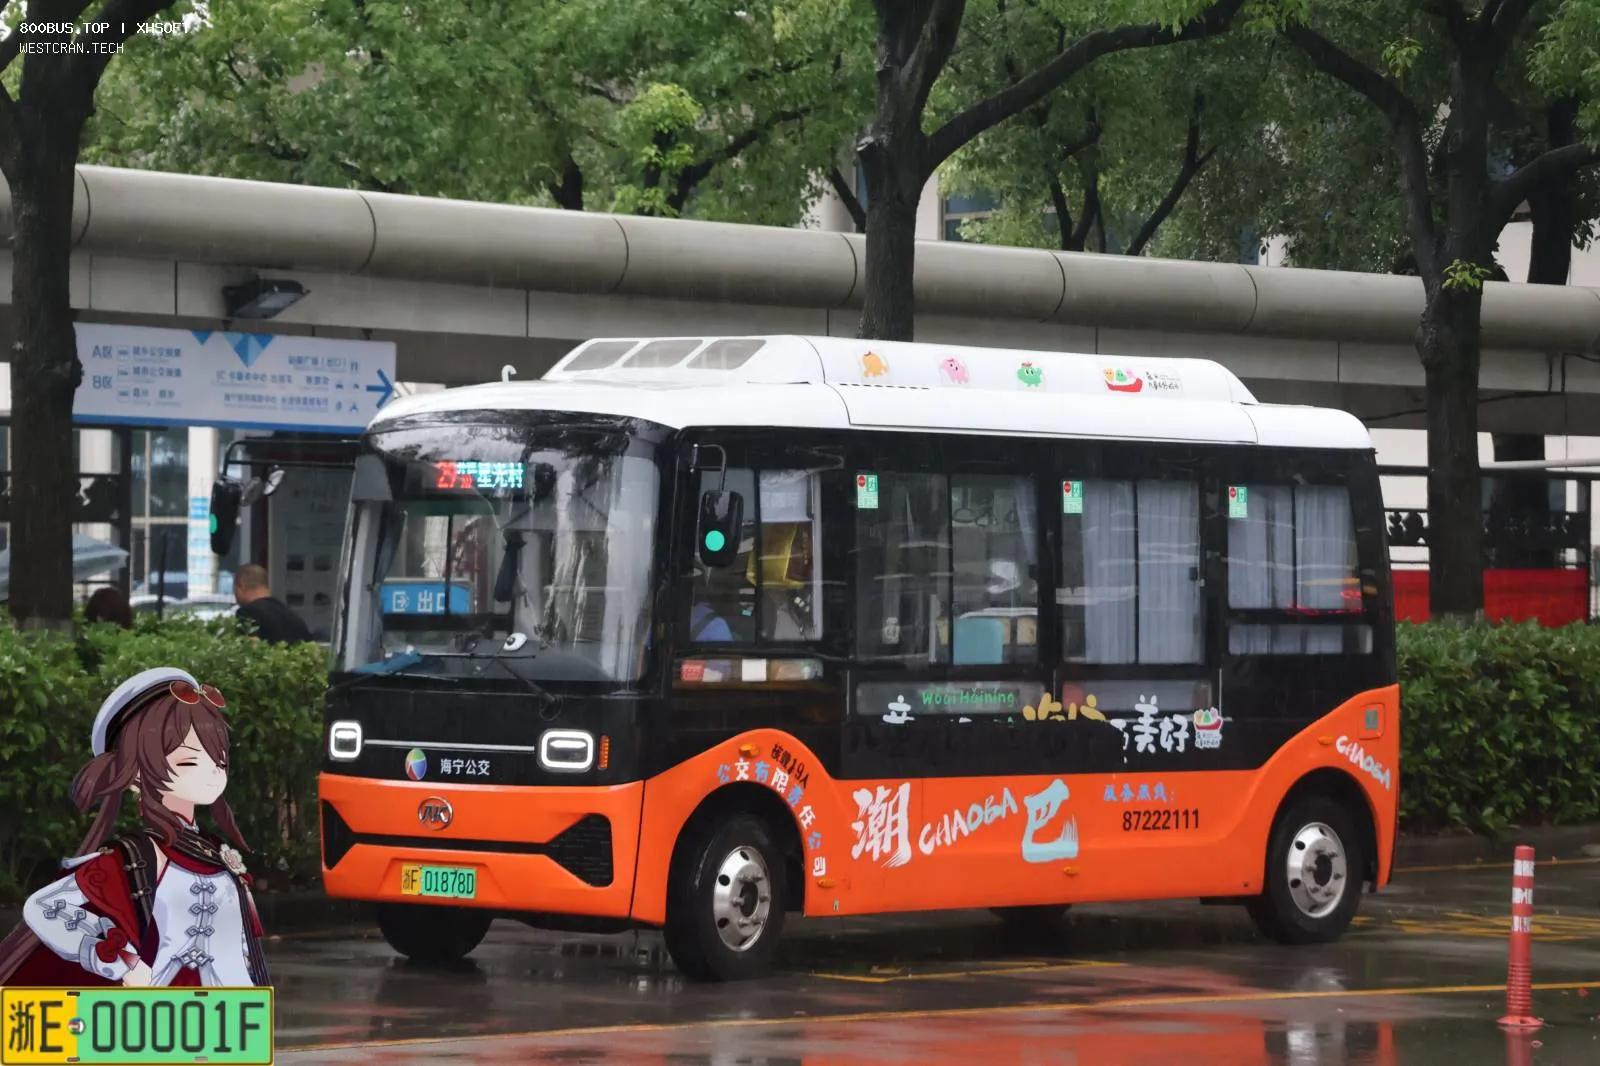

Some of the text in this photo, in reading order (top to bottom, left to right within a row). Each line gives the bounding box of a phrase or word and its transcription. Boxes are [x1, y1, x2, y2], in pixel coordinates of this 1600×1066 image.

[92, 344, 112, 359] A区
[92, 375, 112, 389] B区
[477, 461, 523, 488] 星光村
[440, 758, 491, 777] 海宁公交
[1335, 735, 1391, 792] CHAOBA
[717, 757, 826, 877] 公交有限责任公司
[851, 778, 1079, 869] 潮 CHAOBA 巴
[1122, 808, 1199, 831] 87222111
[424, 870, 475, 897] 01878D
